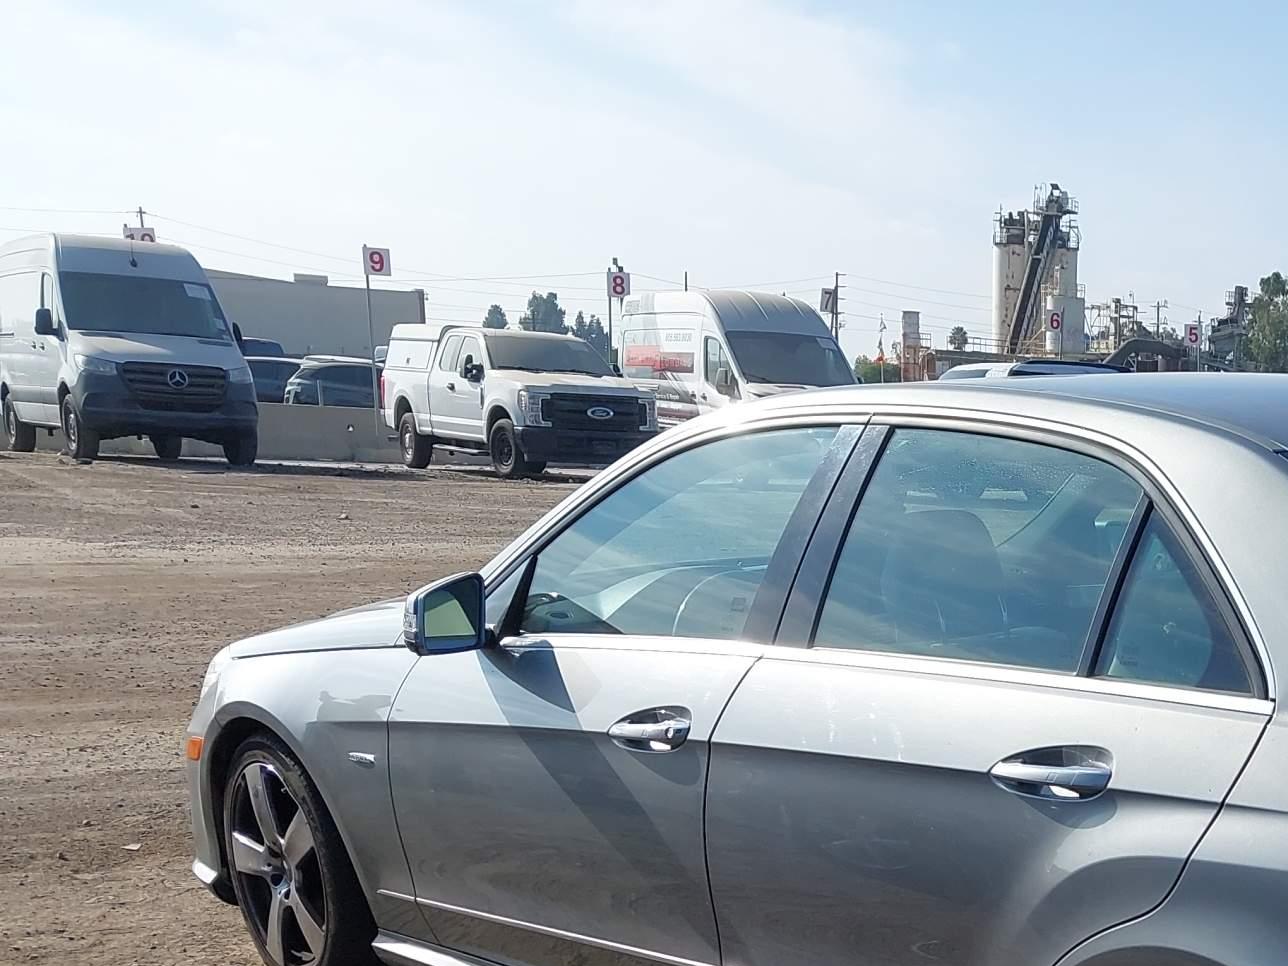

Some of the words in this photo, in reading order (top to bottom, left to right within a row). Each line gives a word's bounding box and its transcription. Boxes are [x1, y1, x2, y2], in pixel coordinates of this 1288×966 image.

[368, 250, 385, 273] 9
[612, 275, 625, 295] 8
[824, 291, 833, 310] 7
[1050, 312, 1061, 330] 6
[1188, 326, 1199, 343] 5
